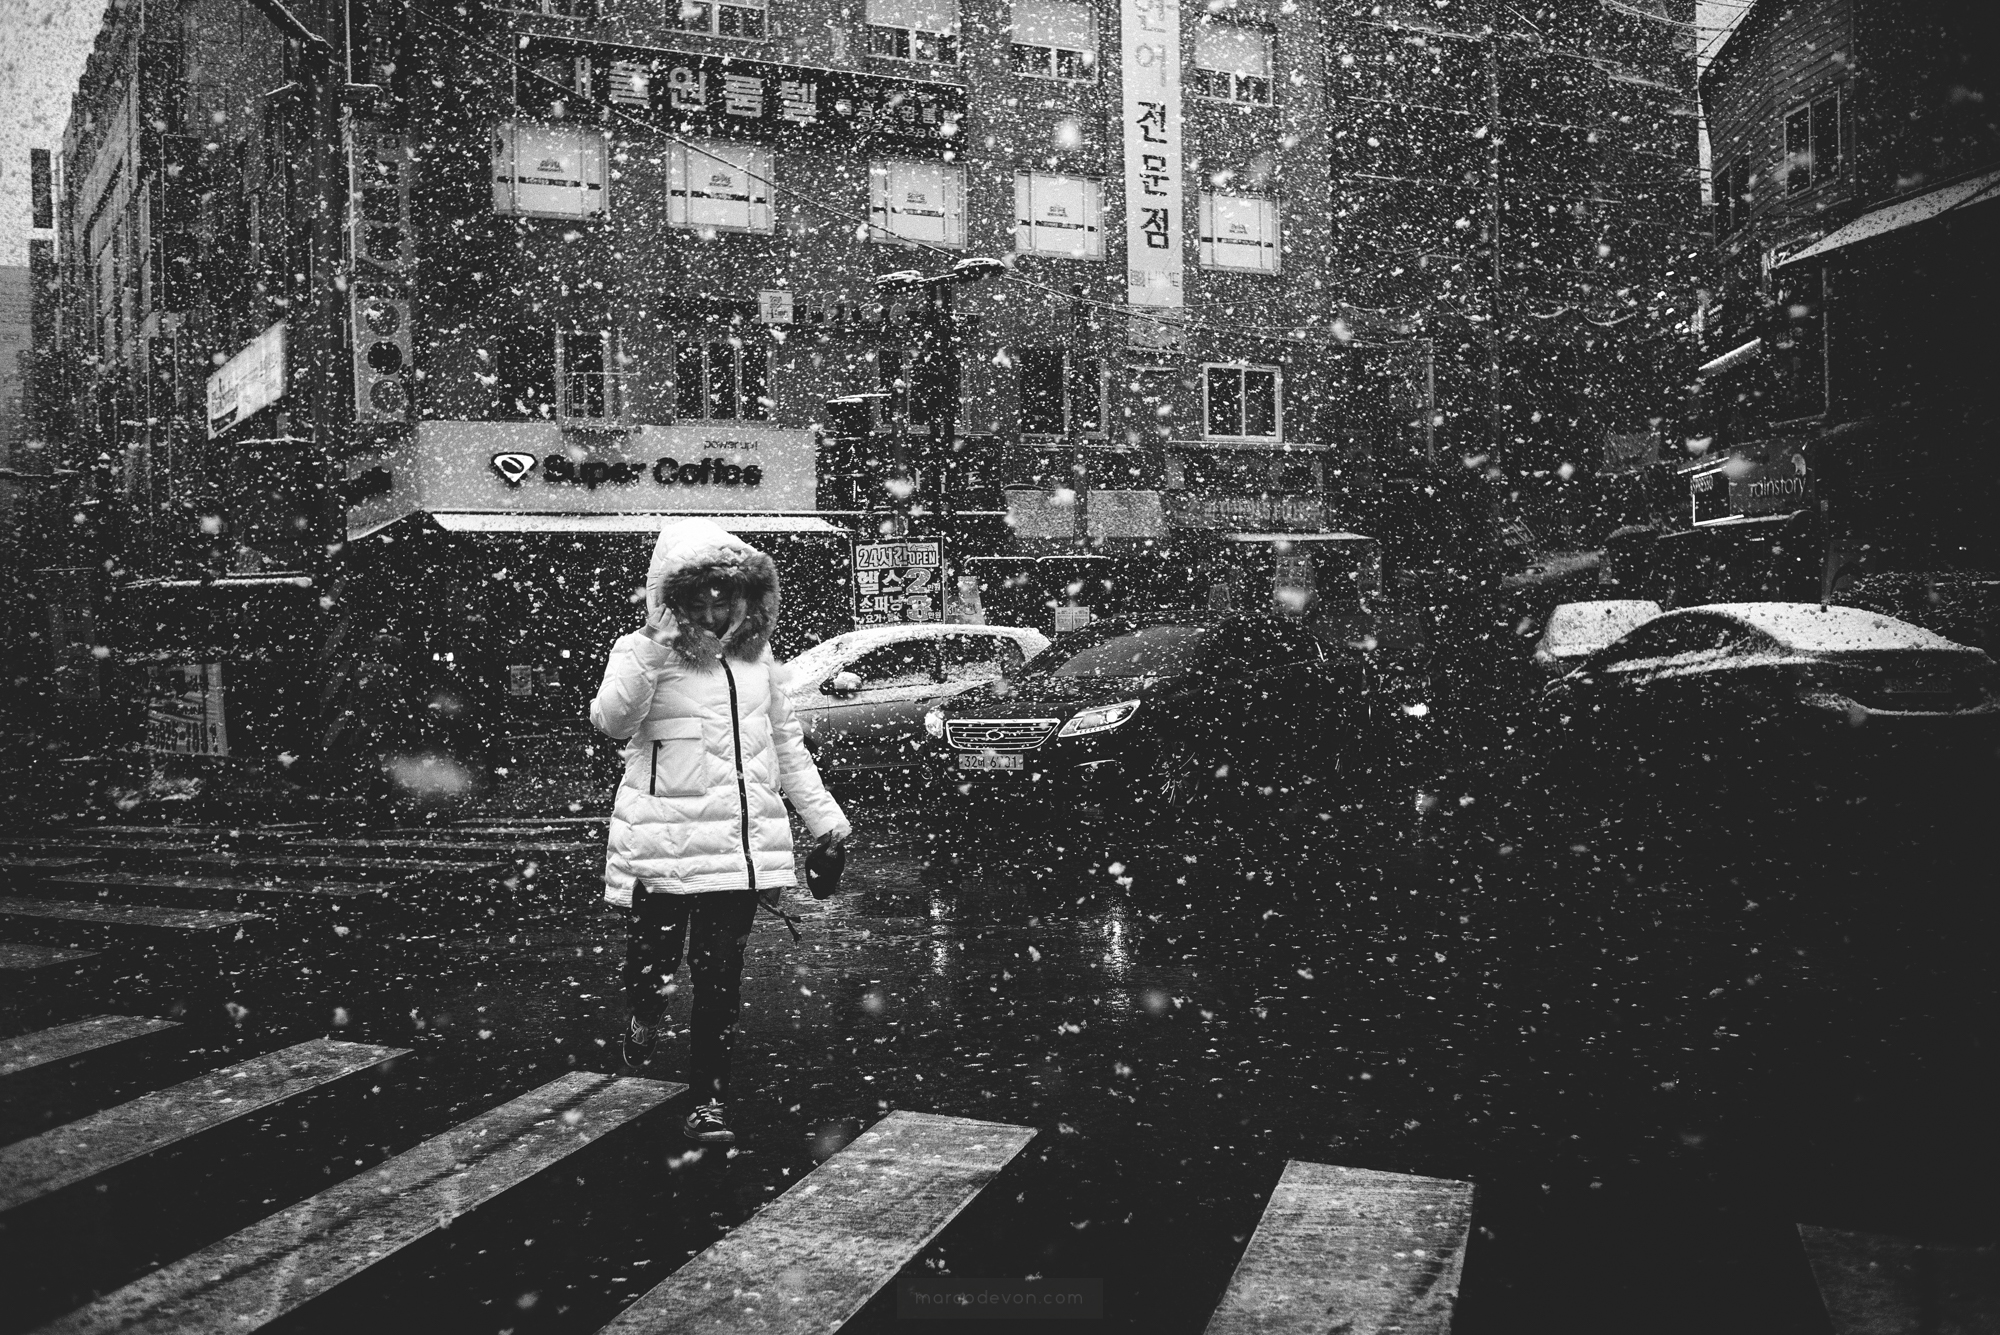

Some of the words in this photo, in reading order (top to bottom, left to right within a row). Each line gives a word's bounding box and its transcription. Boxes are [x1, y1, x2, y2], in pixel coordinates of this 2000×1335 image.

[1136, 101, 1170, 249] 전문점
[703, 440, 739, 451] power
[543, 455, 647, 489] Super
[653, 457, 763, 486] Coffee
[858, 546, 908, 568] 24시간
[908, 550, 936, 566] OPEN
[857, 569, 903, 595] 헬스
